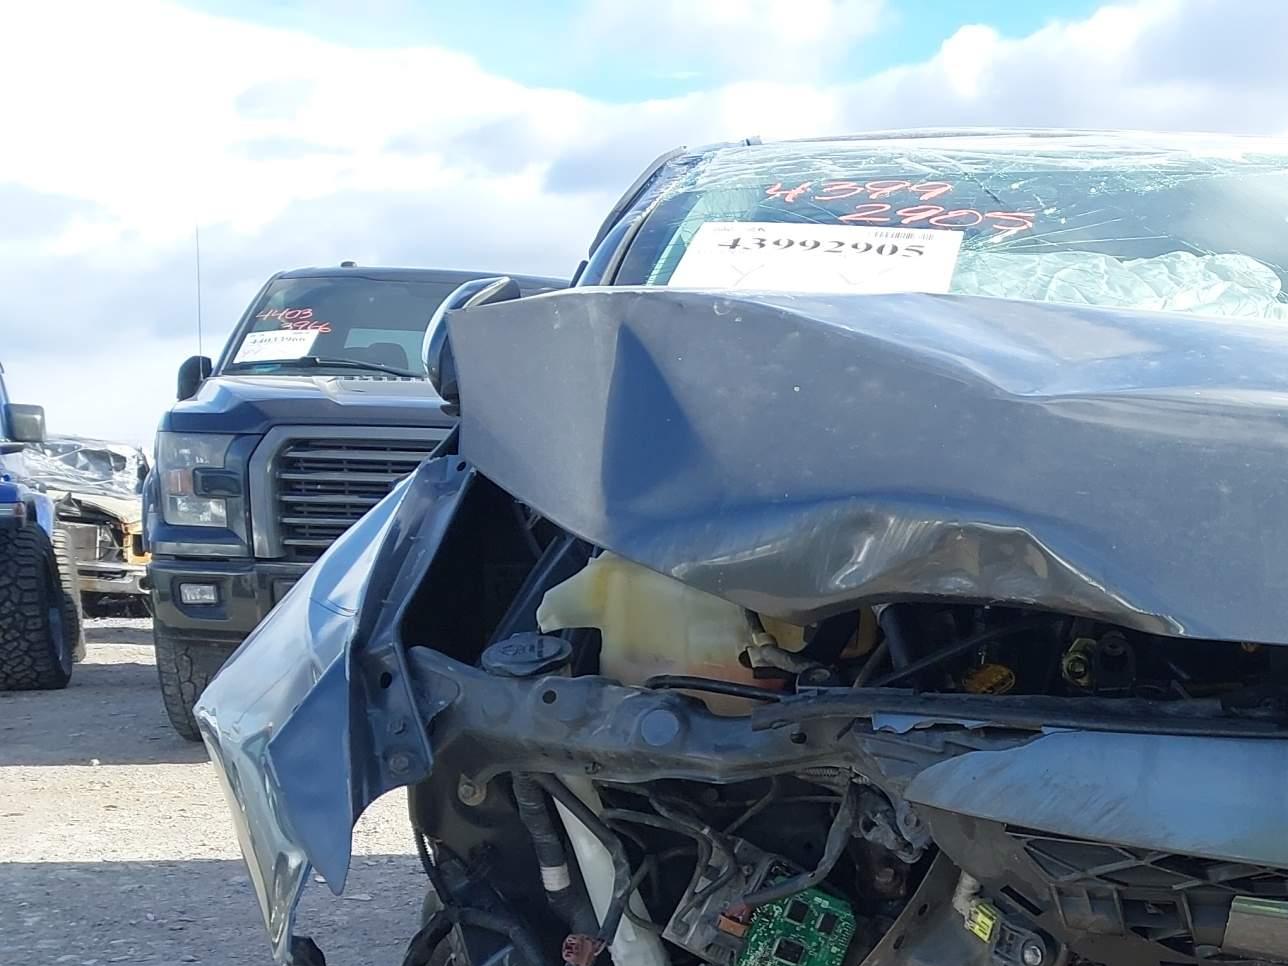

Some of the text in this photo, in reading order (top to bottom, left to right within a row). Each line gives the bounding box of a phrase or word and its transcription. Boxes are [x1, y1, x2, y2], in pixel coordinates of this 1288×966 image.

[765, 179, 953, 204] 4399
[838, 203, 1036, 240] 2905
[717, 237, 926, 258] 43992905
[255, 308, 313, 321] 4403
